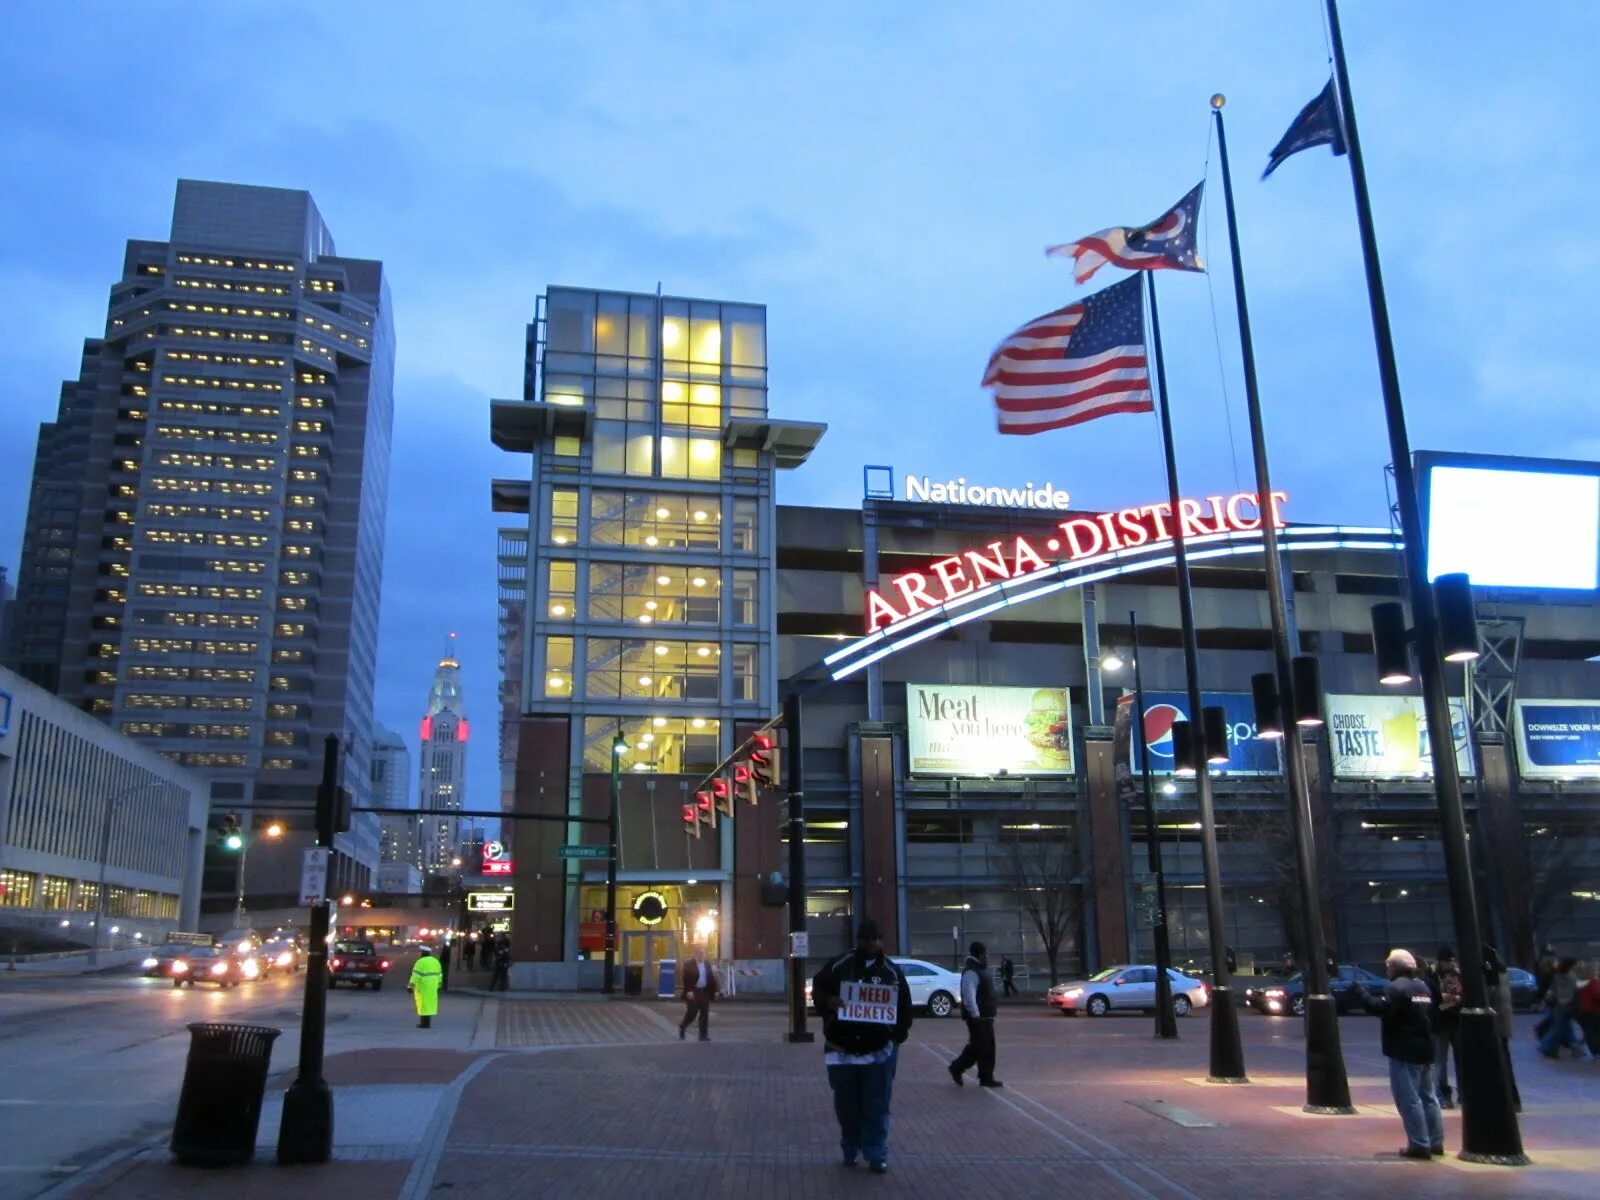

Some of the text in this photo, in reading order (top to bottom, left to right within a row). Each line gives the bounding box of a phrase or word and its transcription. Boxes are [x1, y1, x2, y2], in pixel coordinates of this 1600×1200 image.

[906, 474, 1071, 511] Nationwide
[867, 491, 1288, 634] ARENA DISTRICT
[918, 689, 981, 722] Meat
[1333, 714, 1366, 729] CHOOSE
[1527, 723, 1569, 732] DOWNSIZE
[1569, 723, 1591, 732] YOUR
[950, 722, 980, 741] you
[848, 985, 891, 1004] I NEED
[841, 1004, 895, 1021] TICKETS
